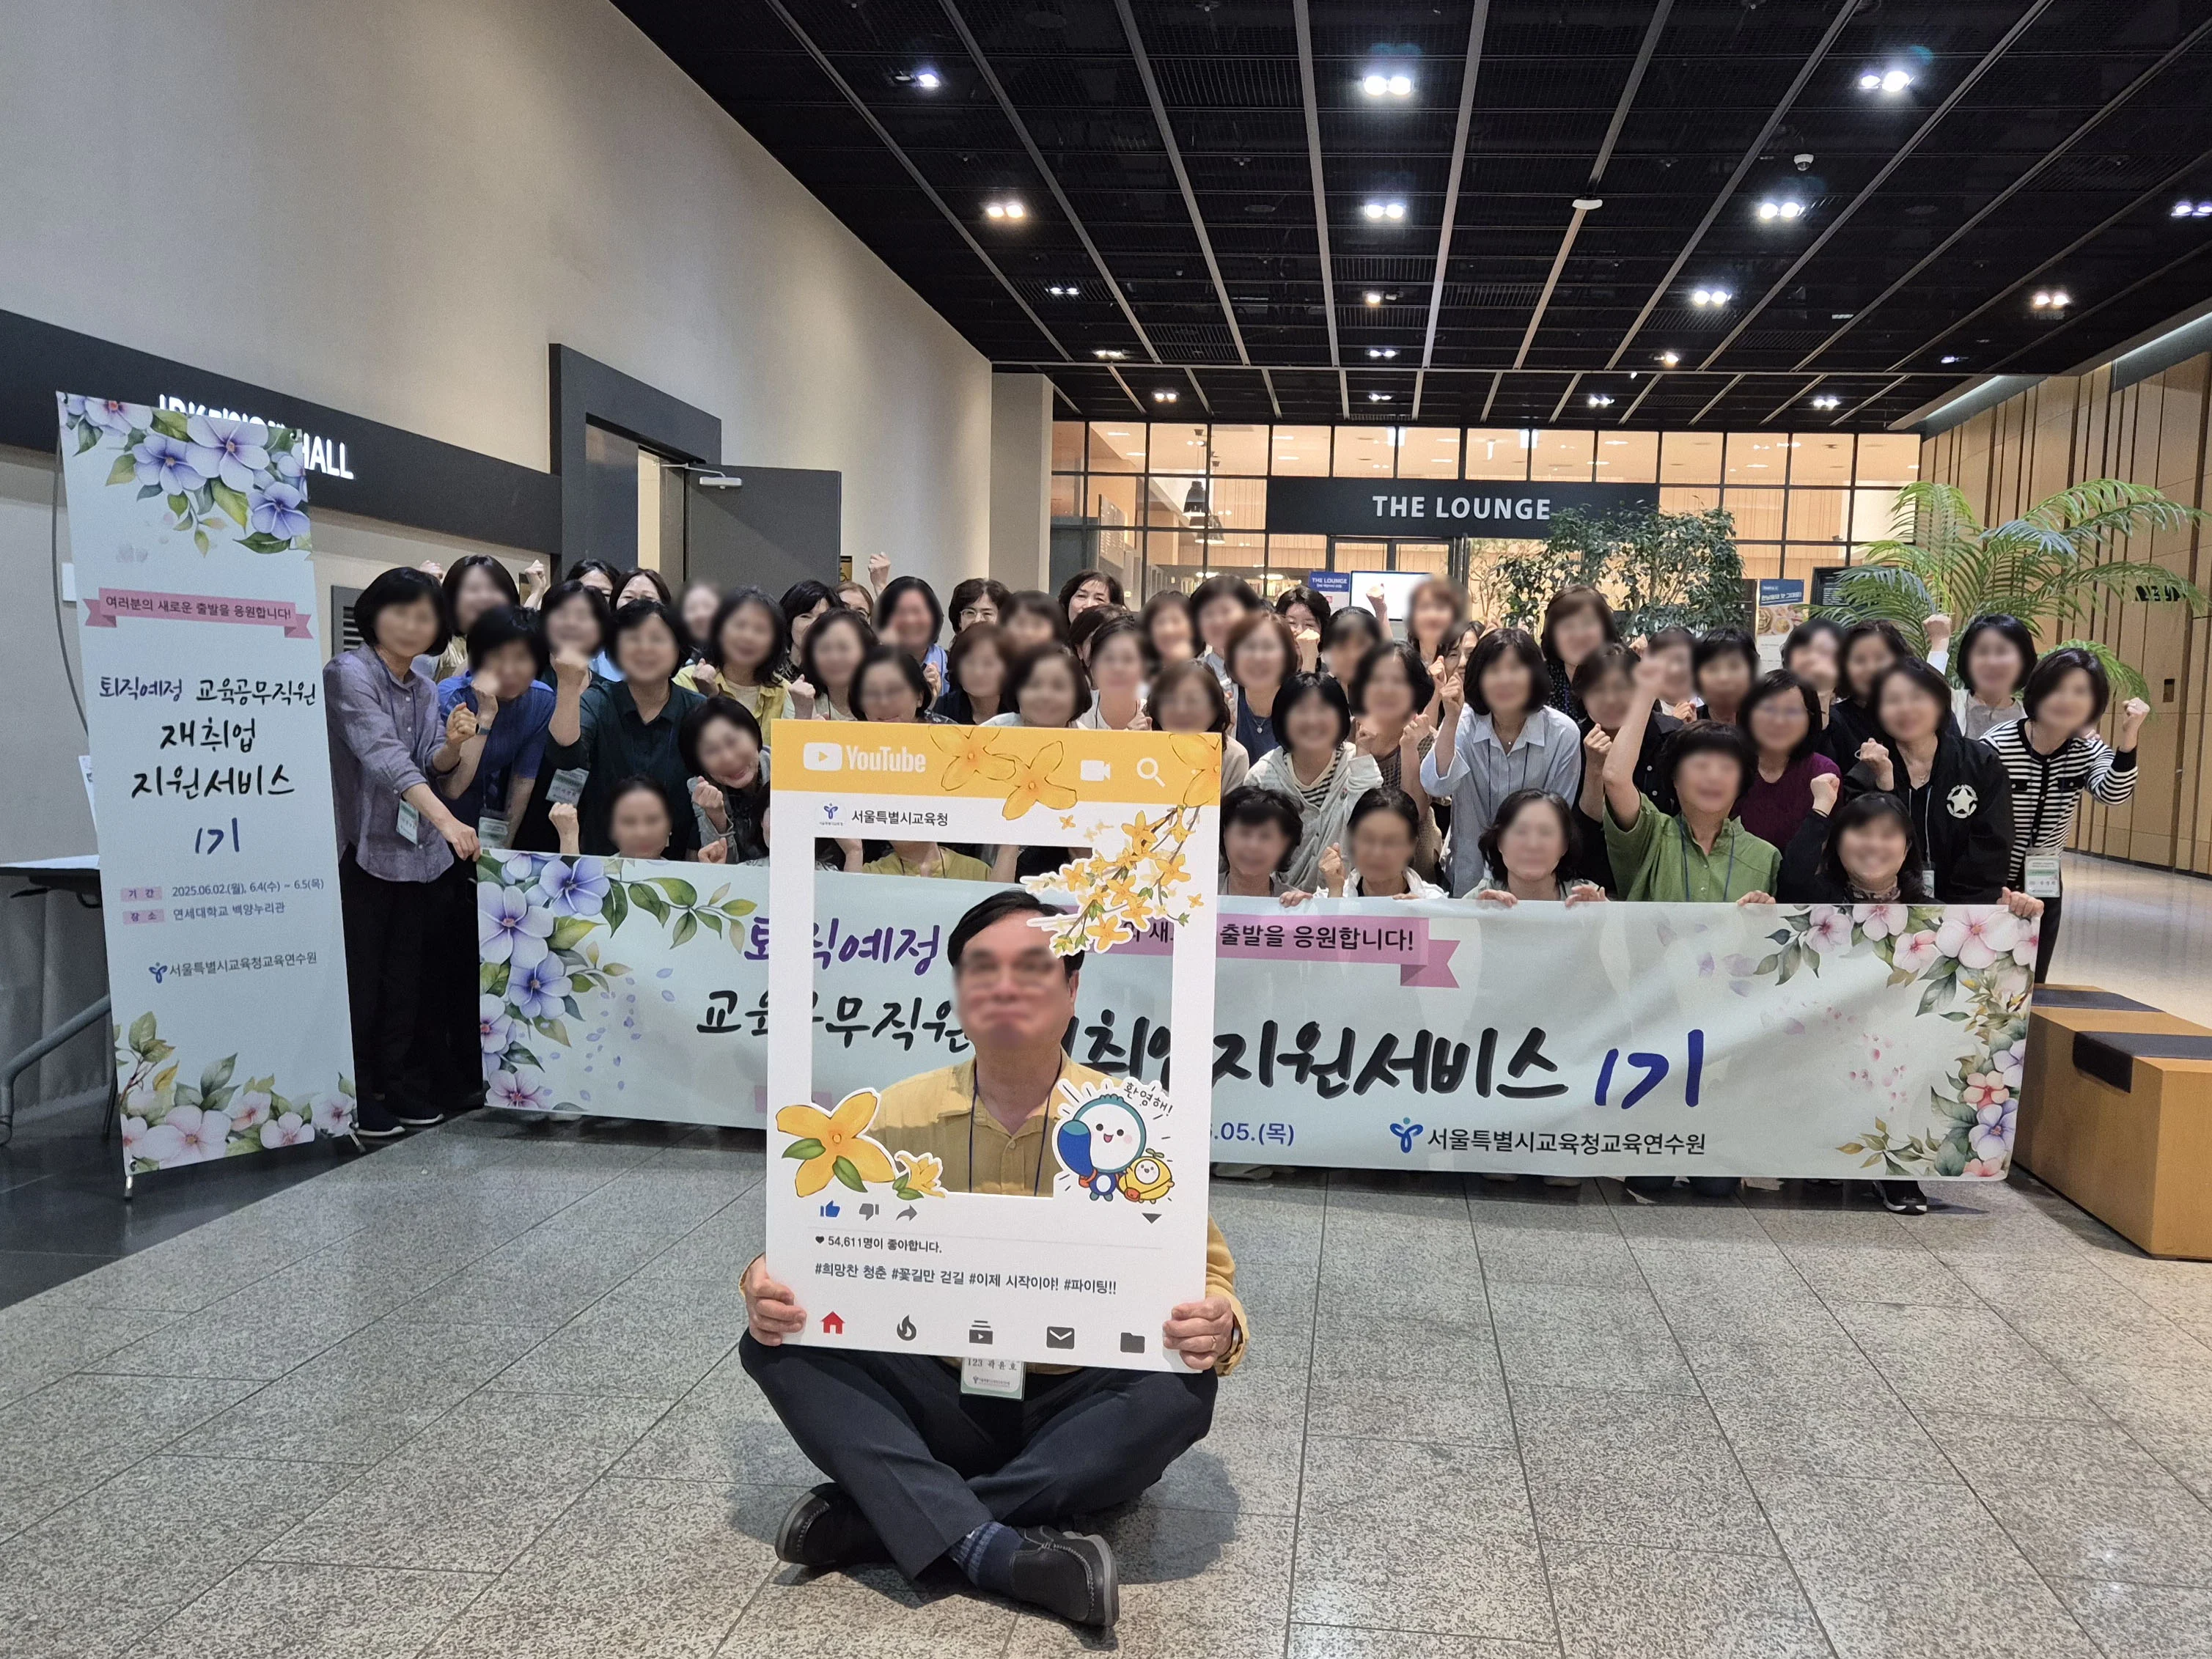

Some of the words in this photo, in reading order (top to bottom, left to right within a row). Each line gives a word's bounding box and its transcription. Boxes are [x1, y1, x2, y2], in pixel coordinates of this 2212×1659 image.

[1373, 496, 1425, 518] THE
[1436, 497, 1551, 520] LOUNGE
[106, 596, 153, 612] 여러분의
[158, 600, 193, 614] 새로운
[196, 602, 229, 617] 출발을
[234, 605, 291, 620] 응원합니다!
[100, 676, 183, 702] 퇴직예정
[196, 678, 316, 706] 교육공무직원
[160, 717, 256, 753] 재취업
[846, 745, 926, 773] YouTube
[131, 764, 295, 800] 지원서비스
[851, 809, 948, 827] 서울특별시교육청
[194, 817, 240, 856] 1기
[294, 878, 325, 890] 6.5(목)
[173, 905, 229, 921] 연세대학교
[232, 902, 285, 916] 백양누리관
[1219, 923, 1285, 949] 출발을
[1293, 925, 1414, 952] 응원합니다!
[169, 952, 317, 977] 서울특별시교육청교육연수원
[697, 990, 971, 1053] 교육무직원
[1211, 1020, 1570, 1099] 지원서비스
[1594, 1029, 1705, 1110] 1기
[1123, 1082, 1173, 1117] 환영해!
[1210, 1122, 1295, 1147] .05.(목)
[1427, 1128, 1706, 1155] 서울특별시교육청교육연수원
[827, 1235, 883, 1250] 54,611명이
[887, 1239, 942, 1254] 좋아합니다.
[815, 1262, 859, 1279] #희망찬
[862, 1265, 887, 1281] 청춘
[891, 1267, 936, 1284] #꽃길만
[940, 1270, 965, 1287] 걷길
[969, 1273, 1001, 1288] #이제
[1006, 1275, 1059, 1292] 시작이야!
[1064, 1278, 1117, 1295] #파이팅!!
[968, 1357, 983, 1368] 123
